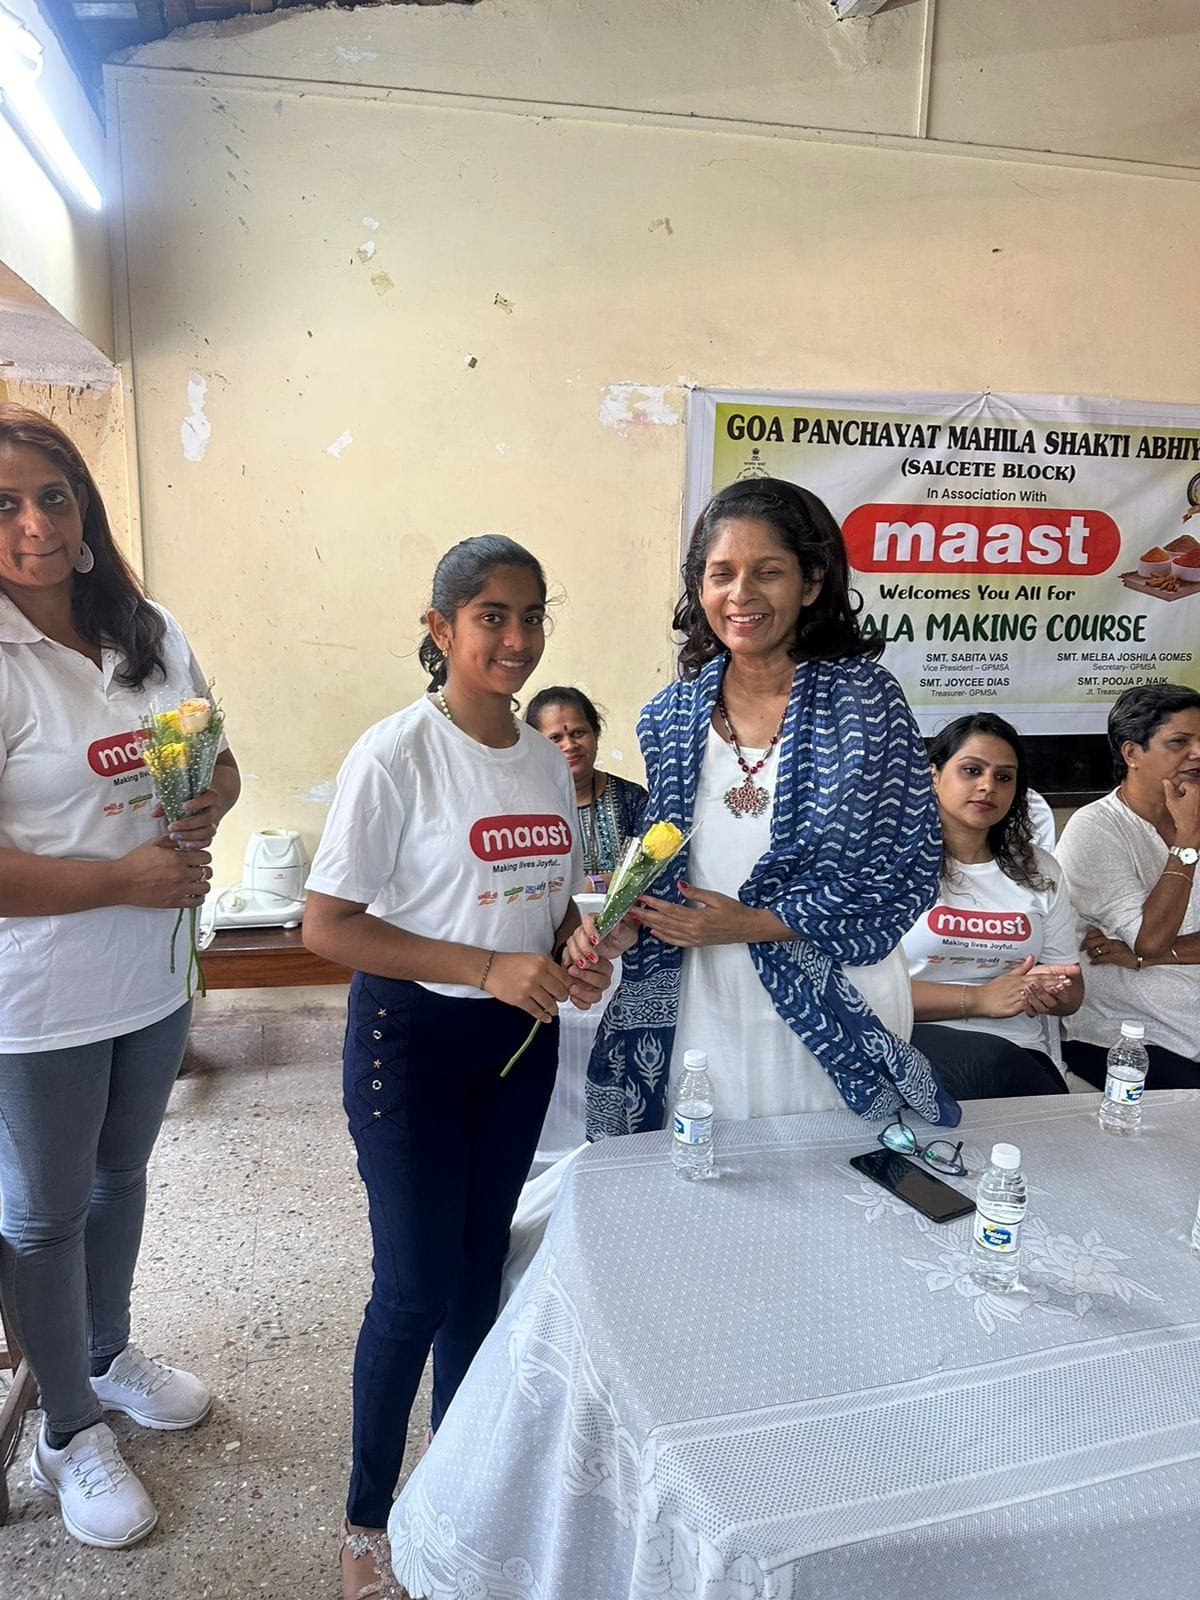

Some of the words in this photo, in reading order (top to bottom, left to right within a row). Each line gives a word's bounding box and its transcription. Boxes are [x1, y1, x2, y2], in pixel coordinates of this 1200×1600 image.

[727, 414, 784, 442] GOA
[792, 417, 941, 449] PANCHAYAT
[947, 425, 1036, 454] MAHILA
[1043, 430, 1131, 458] SHAKTI
[901, 457, 996, 479] (SALCETE
[1002, 464, 1076, 484] BLOCK)
[927, 487, 938, 499] In
[942, 488, 1016, 502] Association
[1020, 490, 1047, 503] With
[872, 515, 1090, 565] maast
[879, 583, 971, 601] Welcomes
[977, 584, 1010, 601] You
[1015, 585, 1041, 601] All
[1048, 585, 1076, 601] For
[861, 613, 915, 643] ALA
[926, 613, 1038, 643] MAKING
[1046, 613, 1148, 643] COURSE
[926, 653, 948, 662] SMT.
[951, 653, 986, 662] SABITA
[989, 653, 1009, 662] VAS
[1057, 652, 1079, 662] SMT.
[1081, 652, 1115, 662] MELBA
[1117, 652, 1157, 662] JOSHILA
[1159, 652, 1192, 662] GOMES
[922, 664, 939, 672] Vice
[940, 664, 974, 672] President
[981, 663, 1010, 672] GPMSA
[1130, 663, 1157, 671] GPMSA
[919, 678, 942, 687] SMT.
[944, 678, 985, 687] JOYCEE
[987, 677, 1010, 687] DIAS
[1077, 677, 1100, 686] SMT.
[1102, 677, 1135, 686] POOJA
[1146, 676, 1169, 686] NAIK
[969, 689, 998, 697] GPMSA
[1097, 688, 1125, 696] Treasur
[482, 821, 570, 853] maast
[492, 862, 518, 873] Making
[519, 860, 536, 870] lives
[937, 913, 1026, 936] maast
[942, 939, 970, 948] Making
